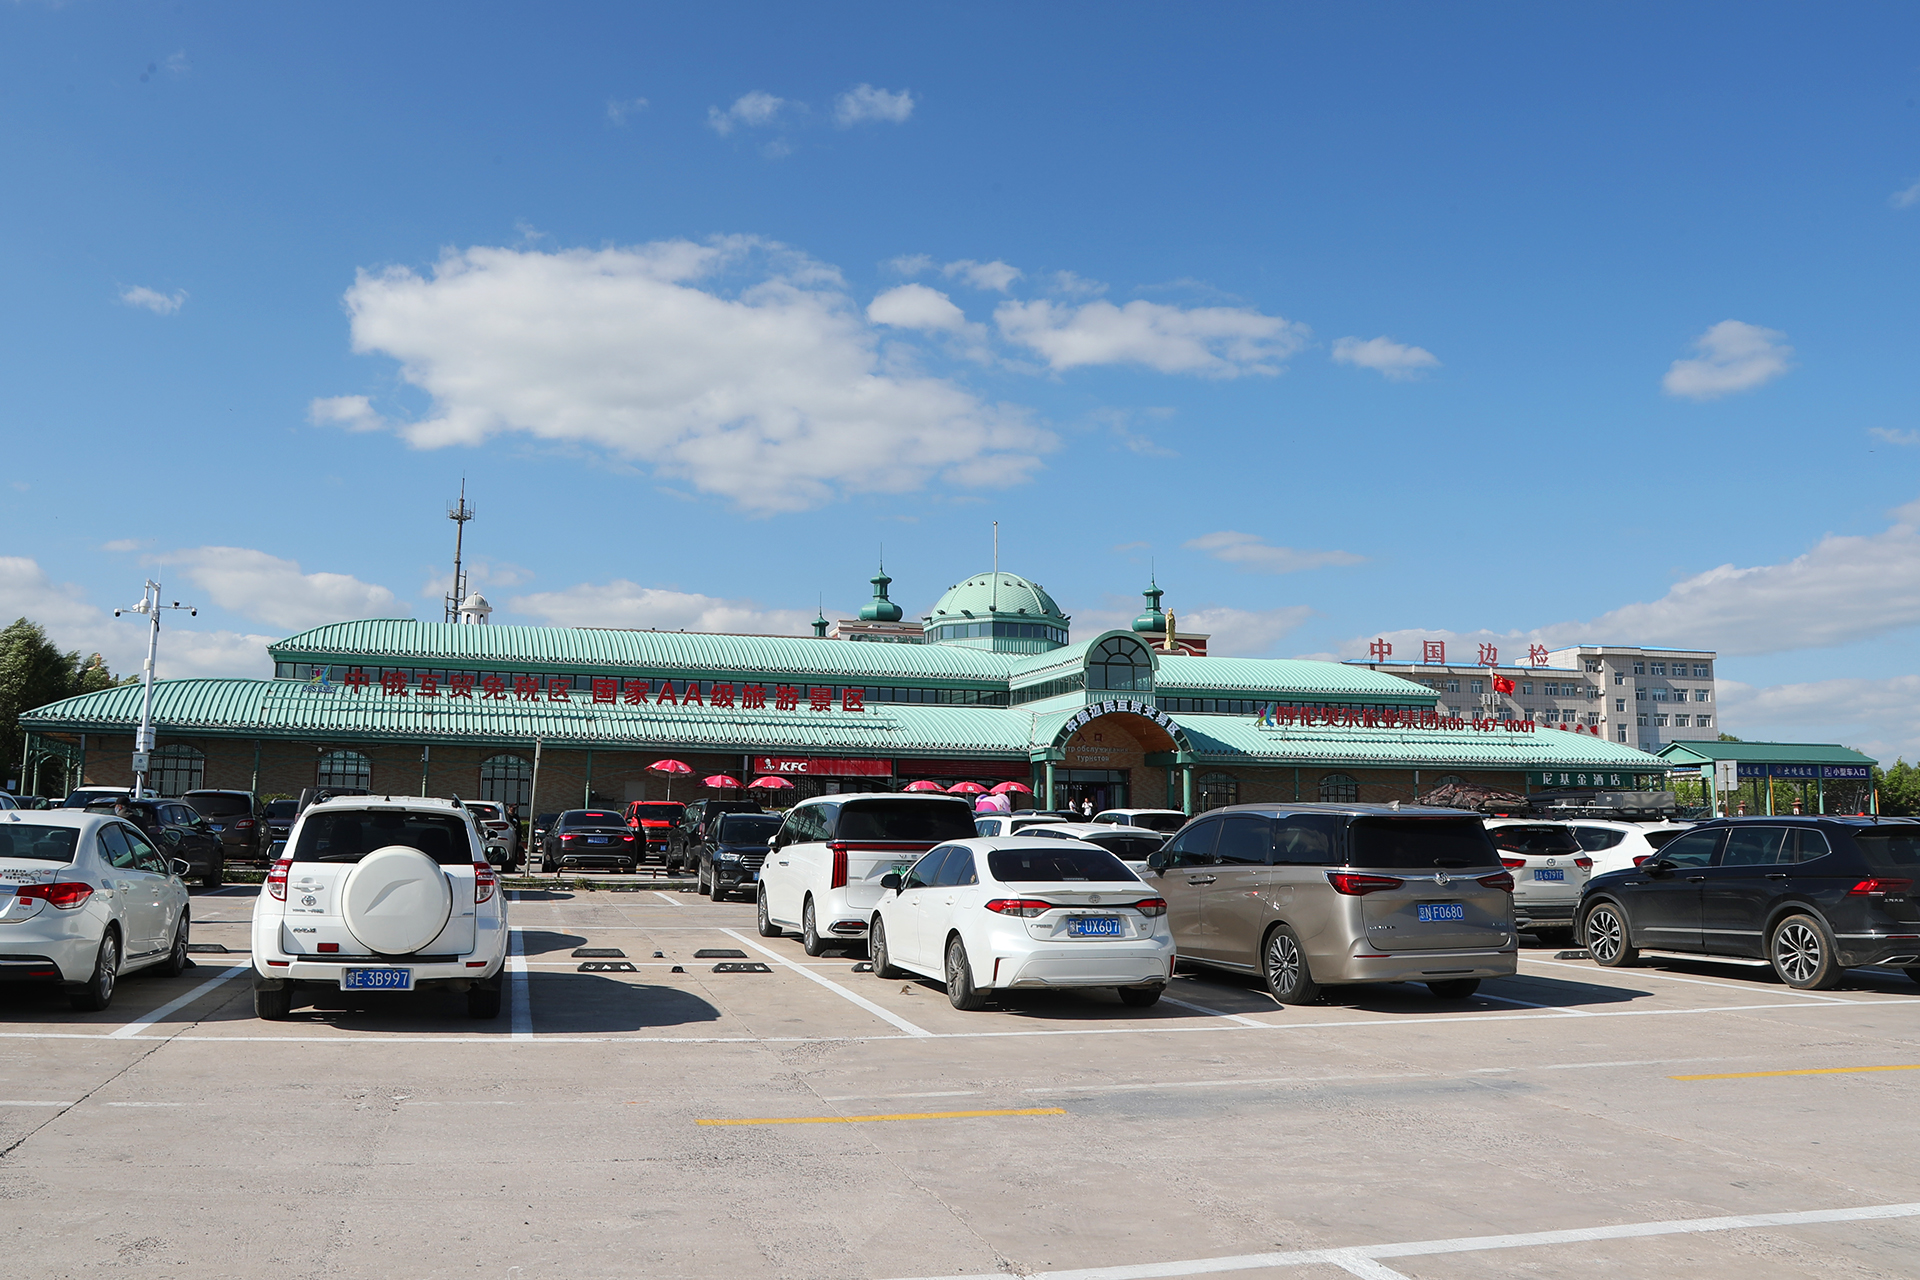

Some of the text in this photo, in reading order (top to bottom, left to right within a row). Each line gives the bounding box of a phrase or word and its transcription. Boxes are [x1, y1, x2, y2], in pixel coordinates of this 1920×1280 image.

[1370, 638, 1549, 667] 中国边检
[344, 668, 865, 712] 中俄互贸免税区 国家AA级旅游景区
[1065, 700, 1181, 736] 中俄边民互贸交易区
[779, 762, 807, 772] KFC
[1832, 768, 1866, 777] 小型车入口
[1543, 773, 1620, 785] 尼基金酒店
